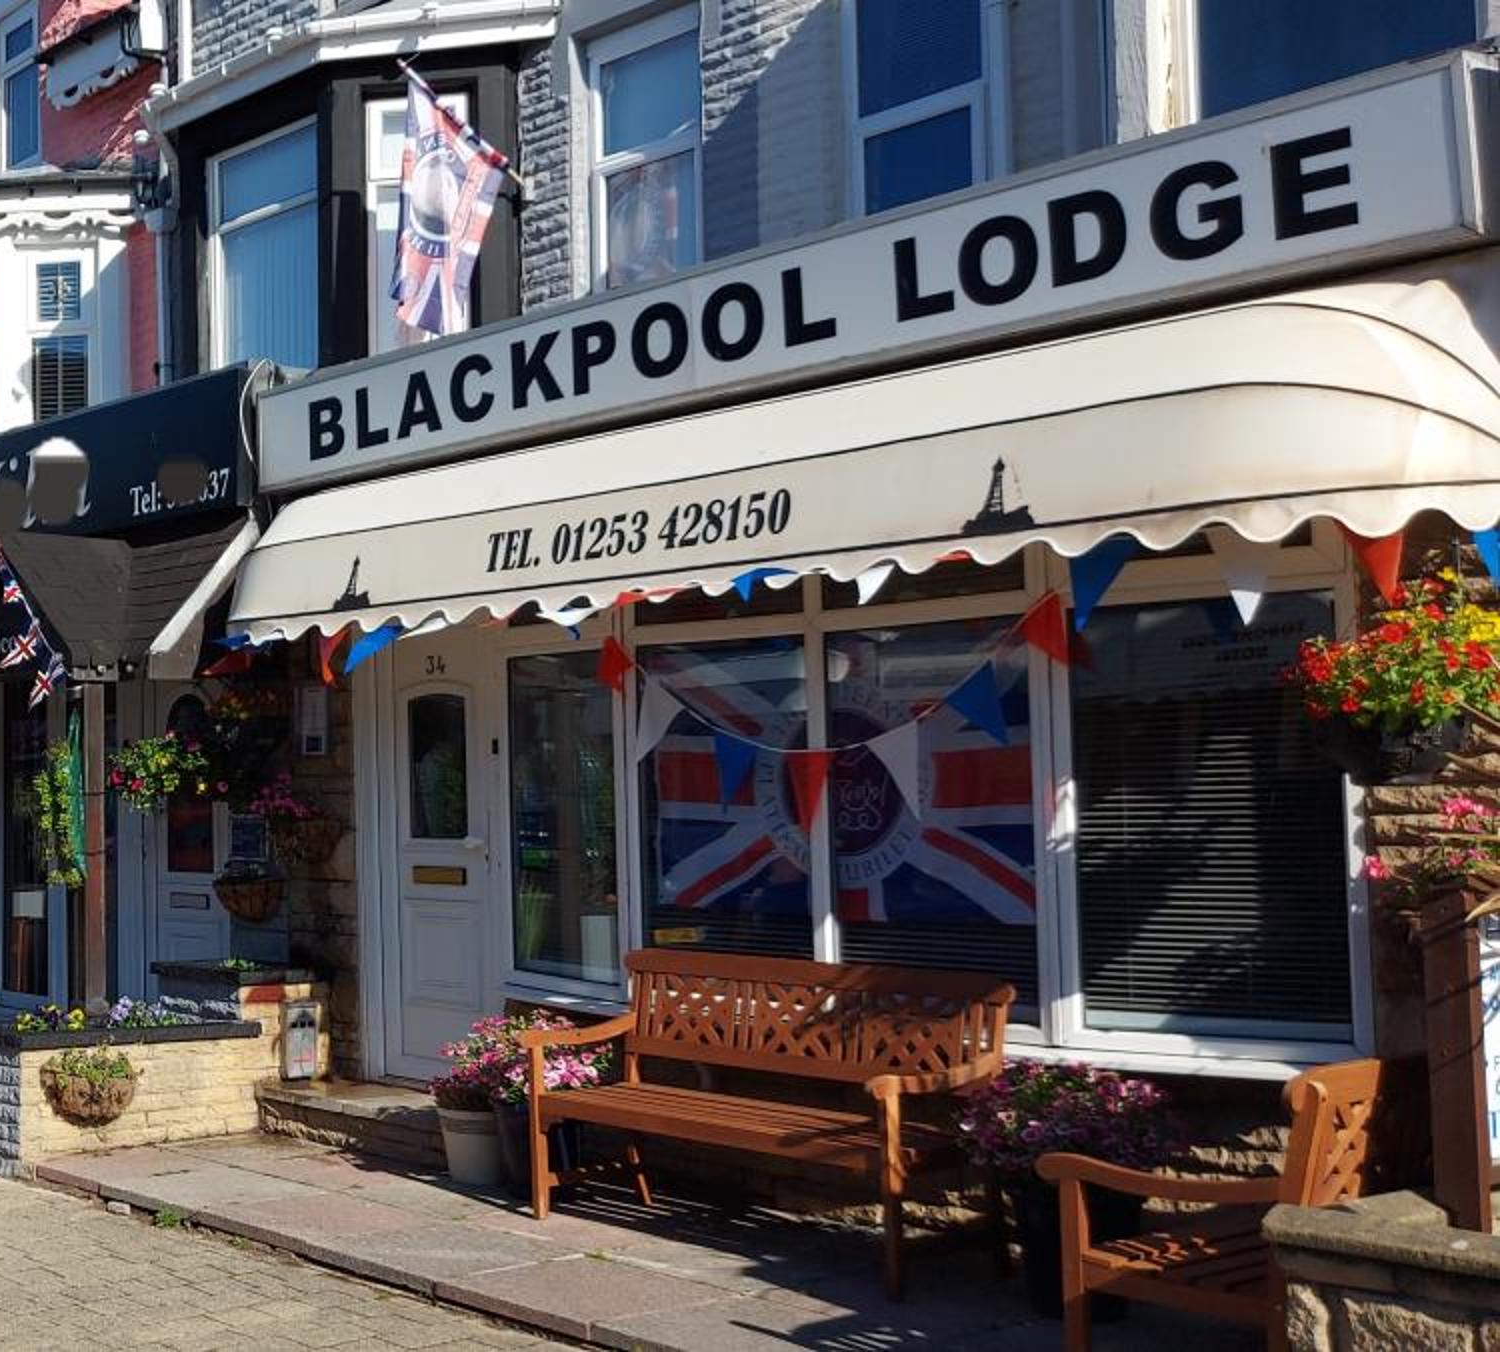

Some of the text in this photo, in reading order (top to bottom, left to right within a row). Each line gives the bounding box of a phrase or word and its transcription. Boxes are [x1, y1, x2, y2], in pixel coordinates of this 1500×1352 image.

[308, 126, 1359, 461] BLACKPOOL LODGE
[129, 481, 161, 516] Tel:
[486, 488, 792, 573] TEL. 01253 428150
[426, 655, 446, 674] 34
